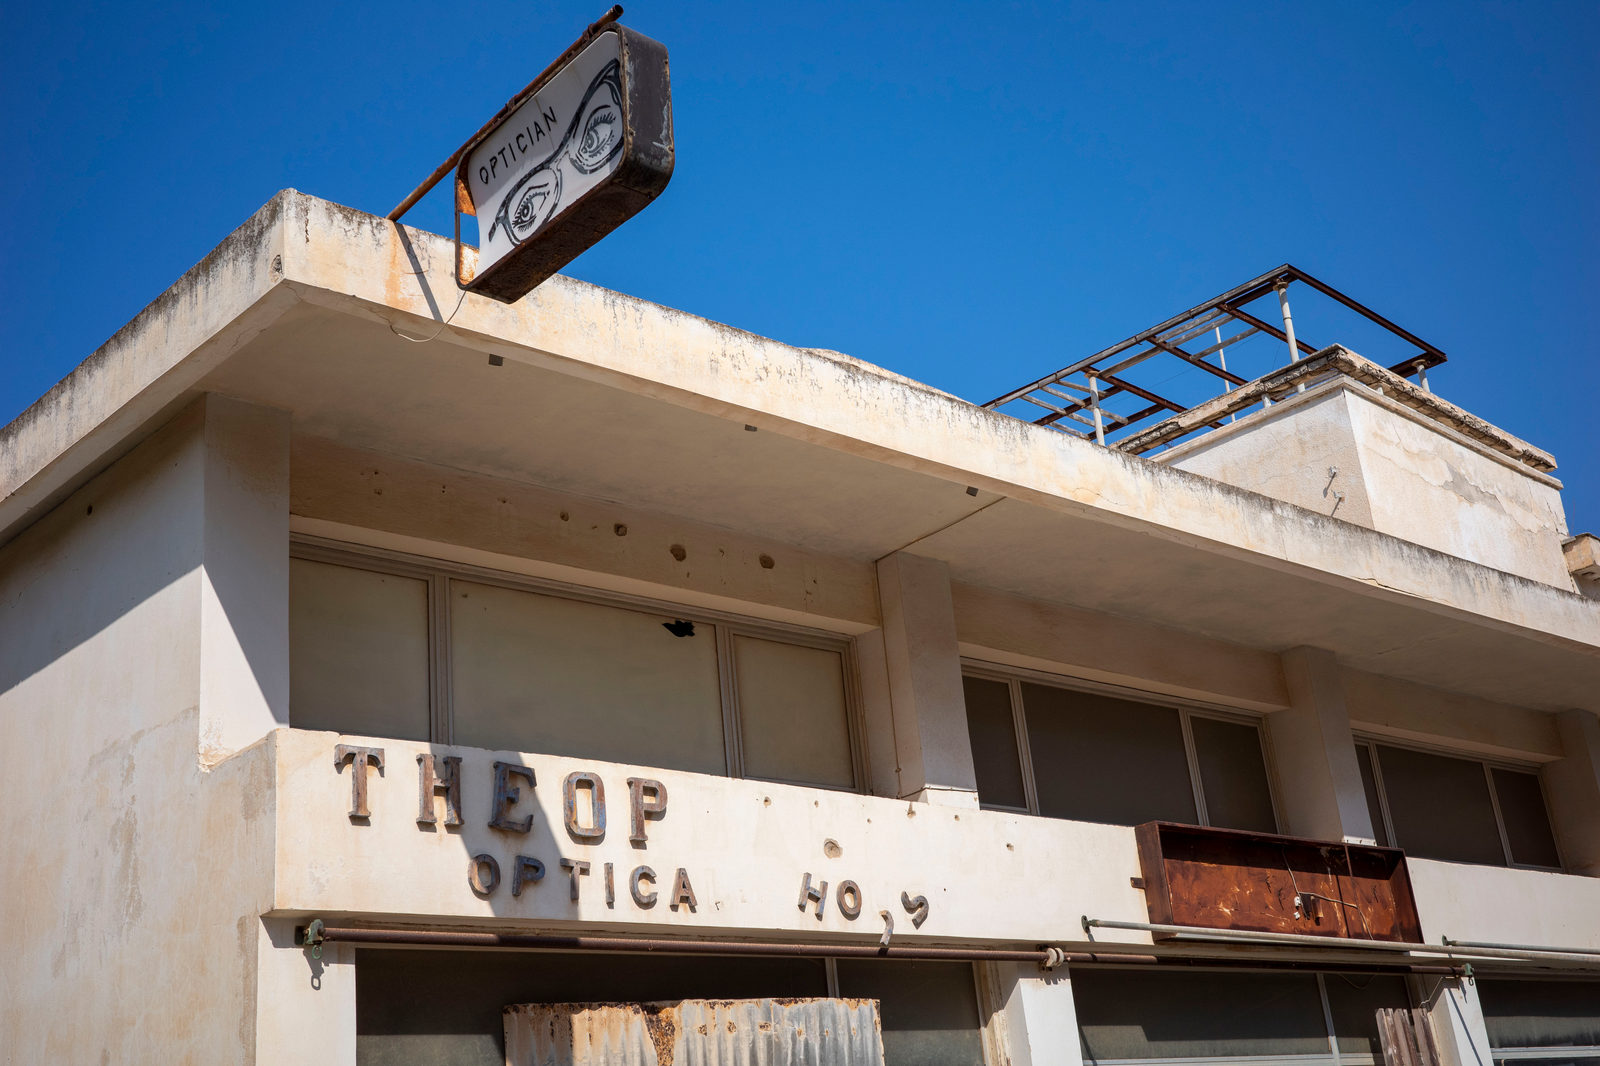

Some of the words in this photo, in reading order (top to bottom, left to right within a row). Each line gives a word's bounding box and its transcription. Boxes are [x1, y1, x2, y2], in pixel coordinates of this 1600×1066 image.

[479, 106, 558, 185] OPTICIAN
[334, 743, 668, 847] THEOP
[467, 853, 699, 912] OPTICA
